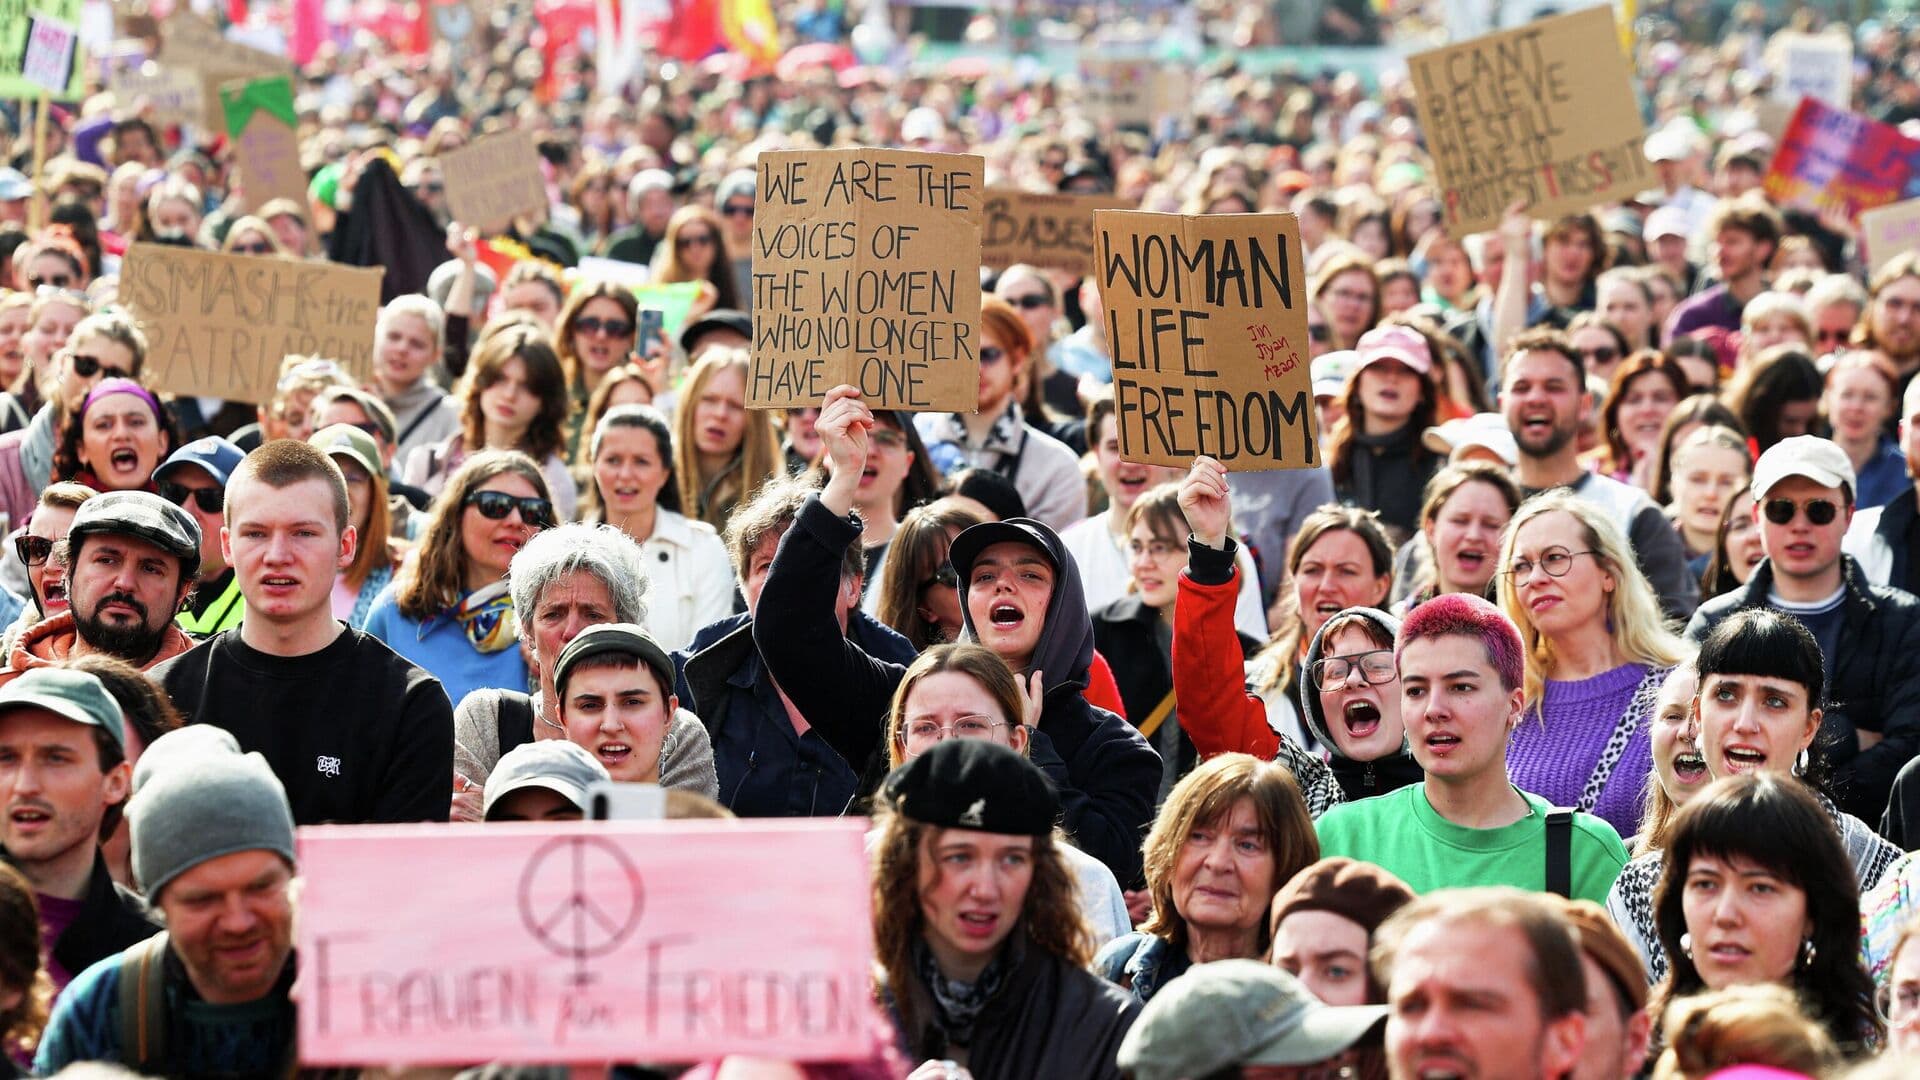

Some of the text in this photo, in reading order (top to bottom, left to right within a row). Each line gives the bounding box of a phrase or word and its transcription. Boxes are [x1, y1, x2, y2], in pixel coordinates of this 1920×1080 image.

[765, 160, 972, 210] WE ARE THE
[872, 225, 919, 260] OF
[753, 269, 956, 316] THE WOMEN
[1103, 230, 1292, 310] WOMAN
[757, 313, 973, 361] WHO NO LONGER
[1110, 308, 1219, 378] LIFE
[753, 357, 931, 406] HAVE ONE
[1119, 379, 1313, 464] FREEDOM
